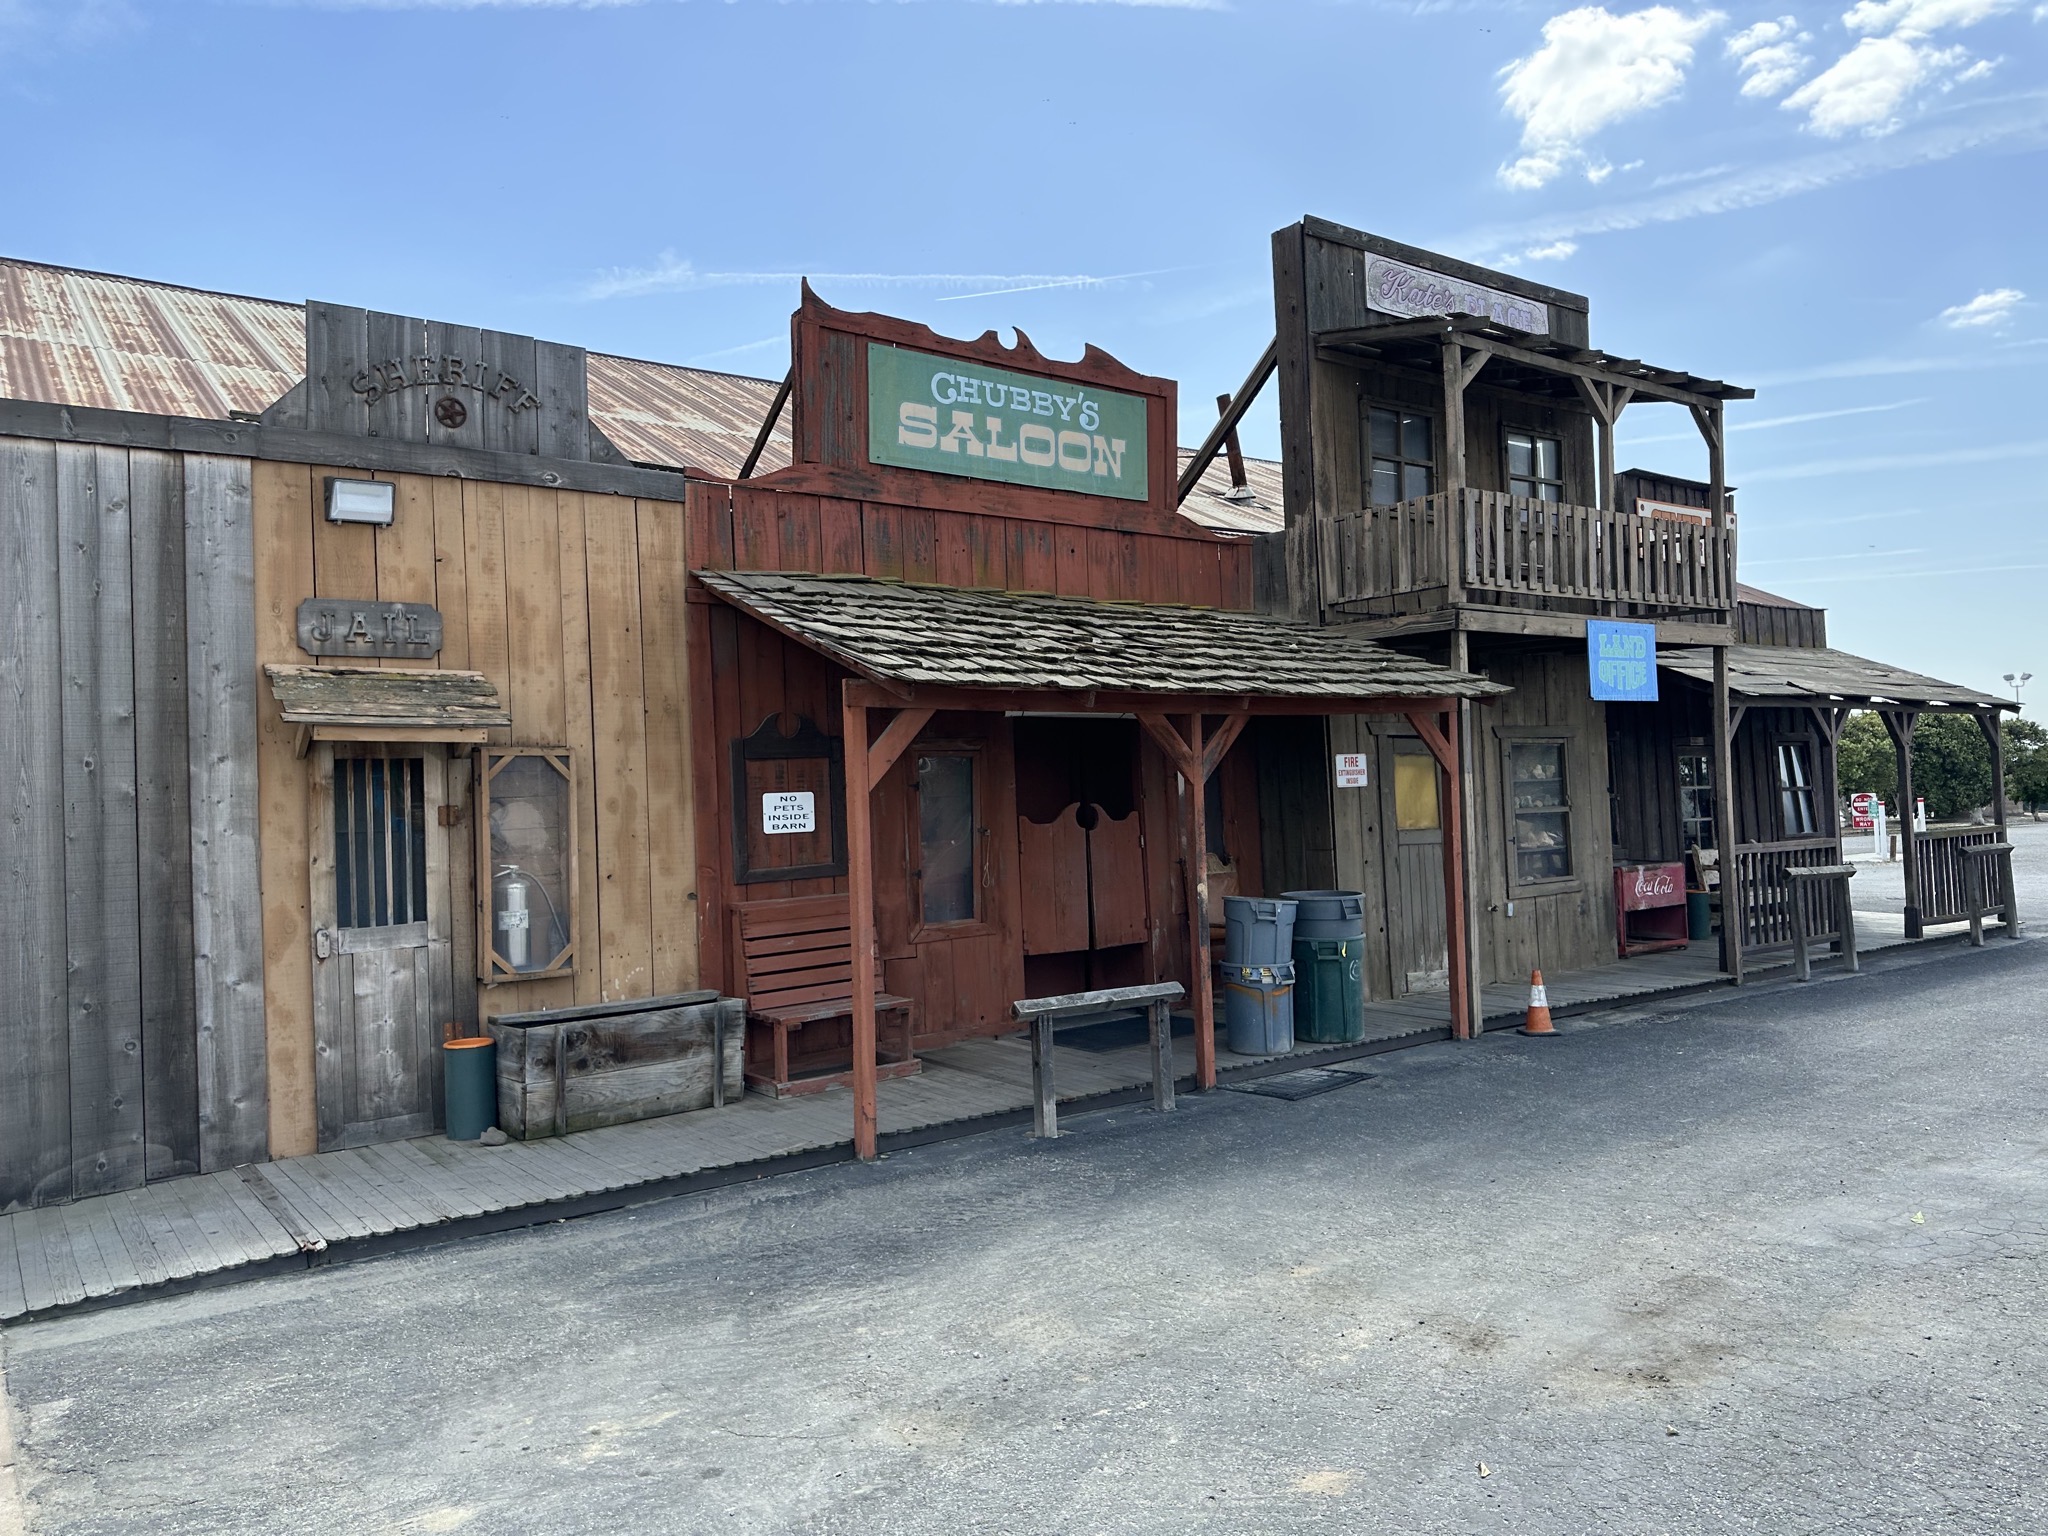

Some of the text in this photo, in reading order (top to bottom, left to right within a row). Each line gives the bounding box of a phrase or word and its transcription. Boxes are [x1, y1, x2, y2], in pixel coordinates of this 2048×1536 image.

[1380, 268, 1455, 312] Kate's
[351, 354, 542, 414] SHERIFF
[930, 371, 1100, 431] CHUBBY'S
[898, 401, 1126, 478] SALOON
[310, 611, 430, 645] JAIL
[1598, 633, 1647, 659] LAND
[1598, 659, 1648, 691] OFFICE
[1343, 756, 1359, 768] FIRE
[1338, 769, 1366, 777] EXTINGUISHER
[1345, 777, 1359, 785] INSIDE
[773, 804, 805, 812] PETS
[779, 795, 798, 803] NO
[768, 813, 810, 821] INSIDE
[772, 822, 807, 831] BARN
